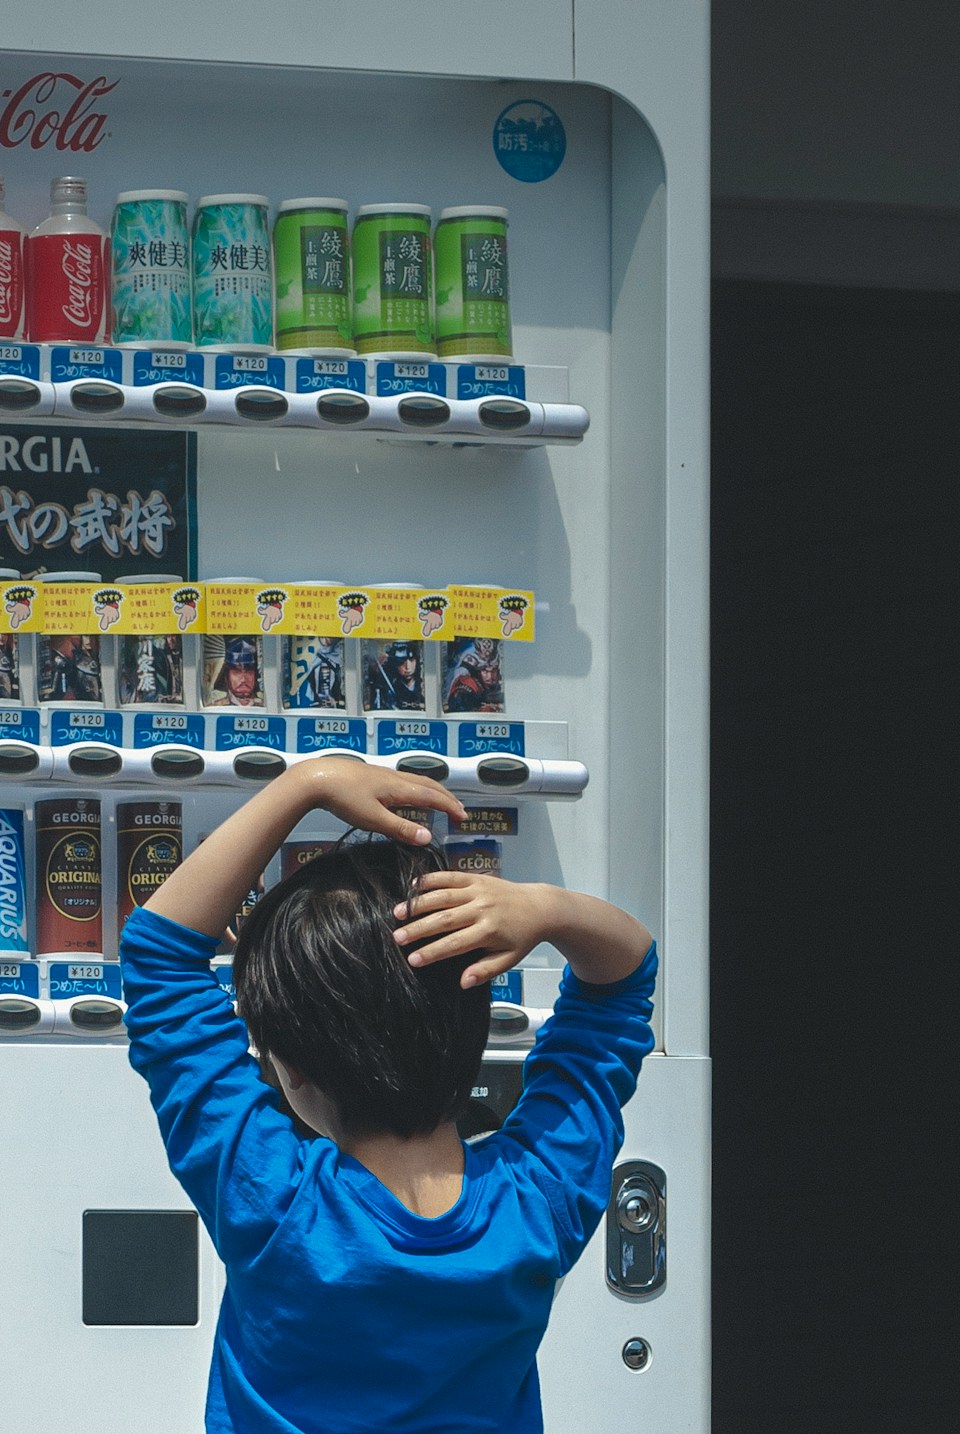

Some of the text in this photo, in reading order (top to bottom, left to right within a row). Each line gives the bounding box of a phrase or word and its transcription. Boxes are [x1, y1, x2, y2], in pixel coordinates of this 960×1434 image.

[320, 231, 343, 289] 綾鷹
[399, 235, 423, 293] 綾鷹
[481, 238, 504, 297] 綾鷹
[62, 239, 92, 327] Coca-Cola
[73, 352, 101, 362] ¥120
[156, 356, 184, 365] ¥120
[237, 360, 265, 368] ¥120
[317, 364, 345, 373] ¥120
[398, 367, 425, 376] ¥120
[479, 370, 506, 379] ¥120
[74, 715, 101, 724] ¥120
[157, 718, 185, 727] ¥120
[238, 720, 266, 729] ¥120
[318, 722, 346, 731] ¥120
[399, 724, 426, 733] ¥120
[479, 726, 507, 735] ¥120
[72, 967, 100, 977] ¥120
